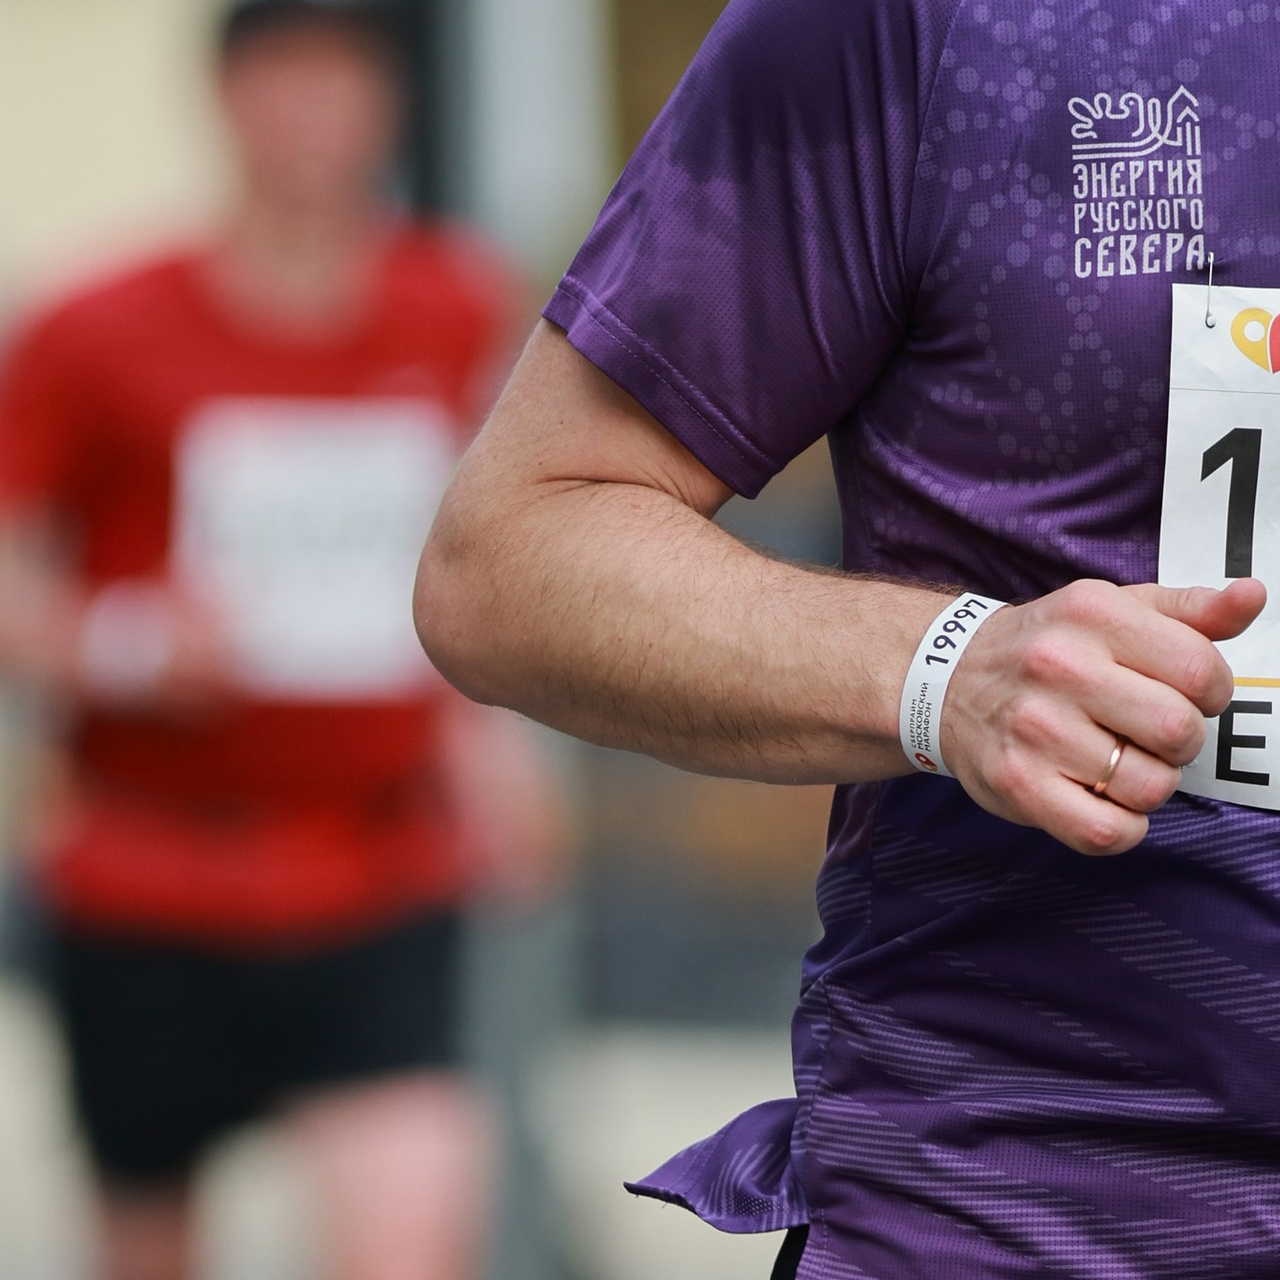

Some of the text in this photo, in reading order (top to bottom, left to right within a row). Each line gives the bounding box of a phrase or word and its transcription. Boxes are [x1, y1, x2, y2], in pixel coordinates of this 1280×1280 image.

[1072, 159, 1202, 199] ЭНЕРГИЯ
[1074, 198, 1204, 234] РУССКОГО
[1075, 233, 1205, 278] СЕВЕРА
[925, 598, 989, 666] 19997
[916, 682, 929, 750] МОСКОВСКИЙ
[923, 702, 932, 752] МАРАФОН
